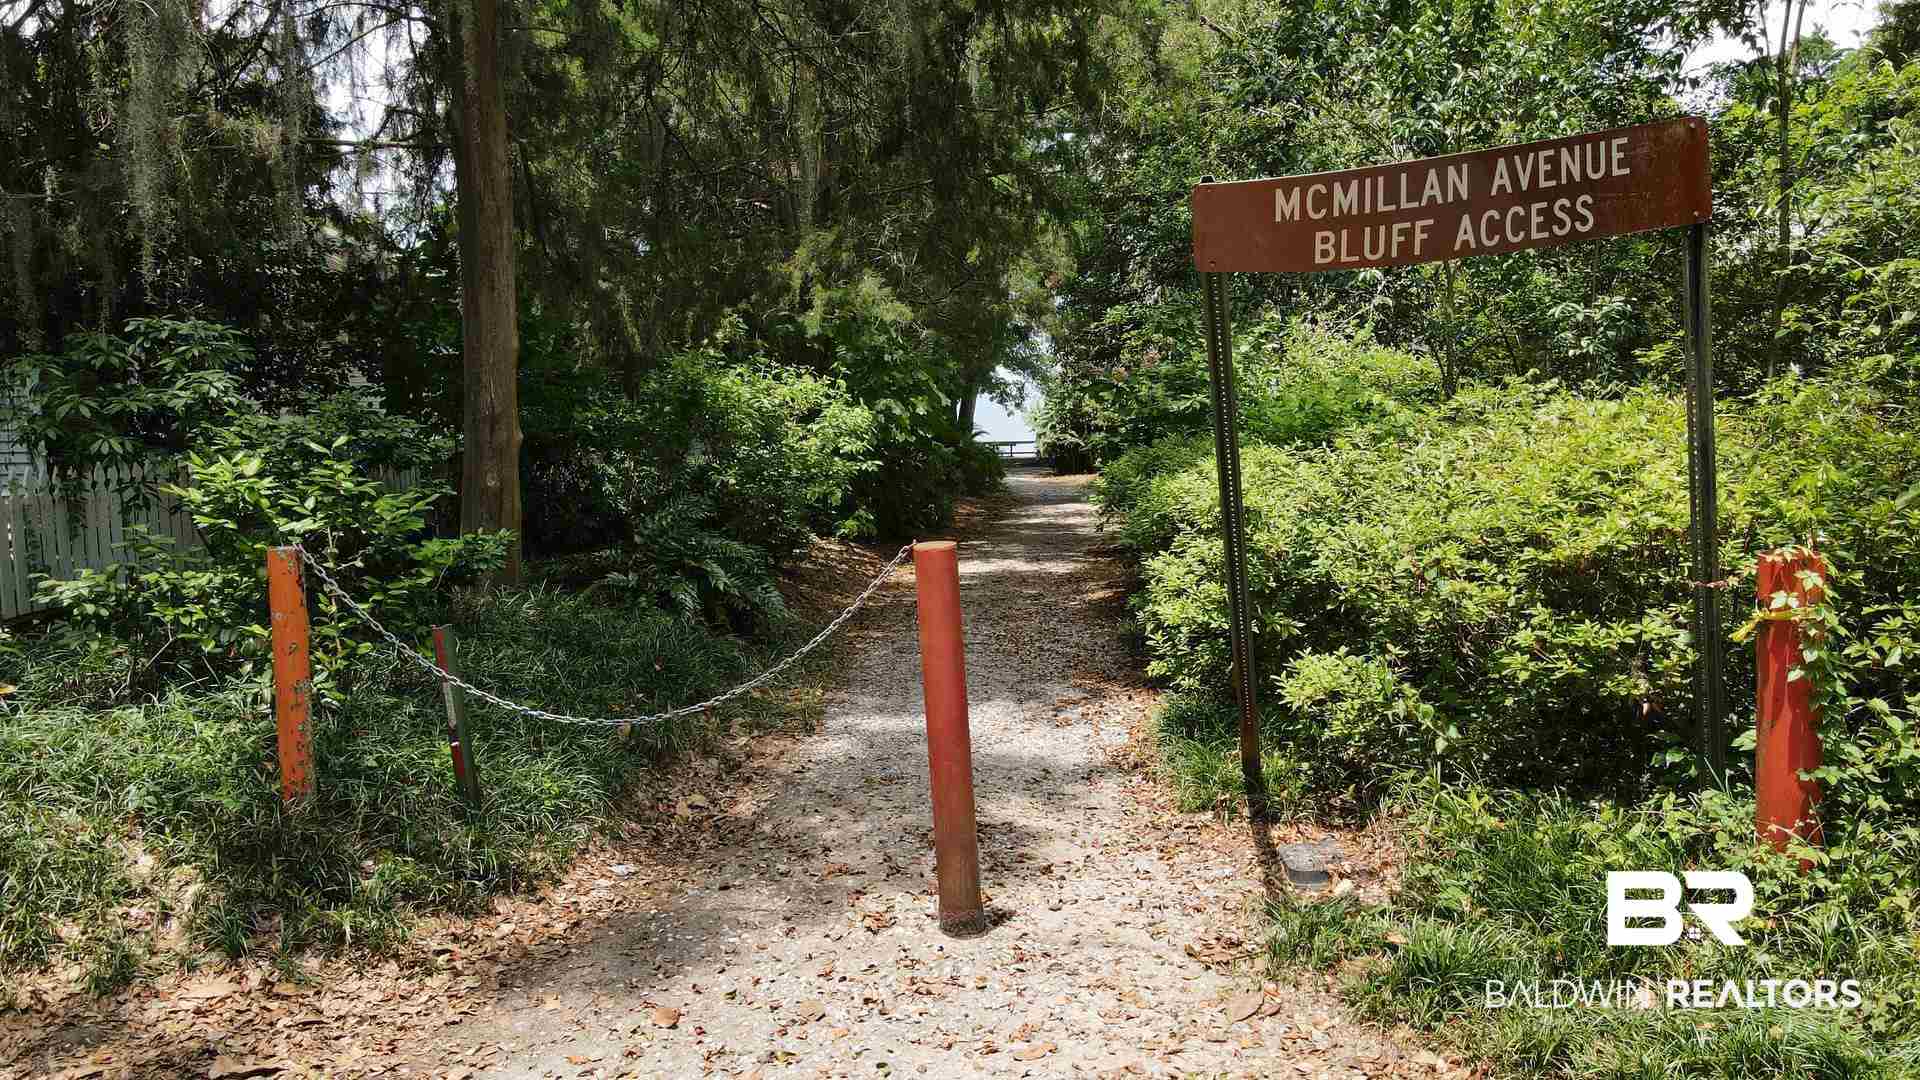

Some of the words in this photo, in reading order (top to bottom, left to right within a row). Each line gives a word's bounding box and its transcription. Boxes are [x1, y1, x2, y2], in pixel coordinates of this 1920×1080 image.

[1274, 163, 1469, 222] MCMILLAN
[1490, 136, 1630, 196] AVENUE
[1314, 219, 1435, 265] BLUFF
[1454, 194, 1595, 250] ACCESS
